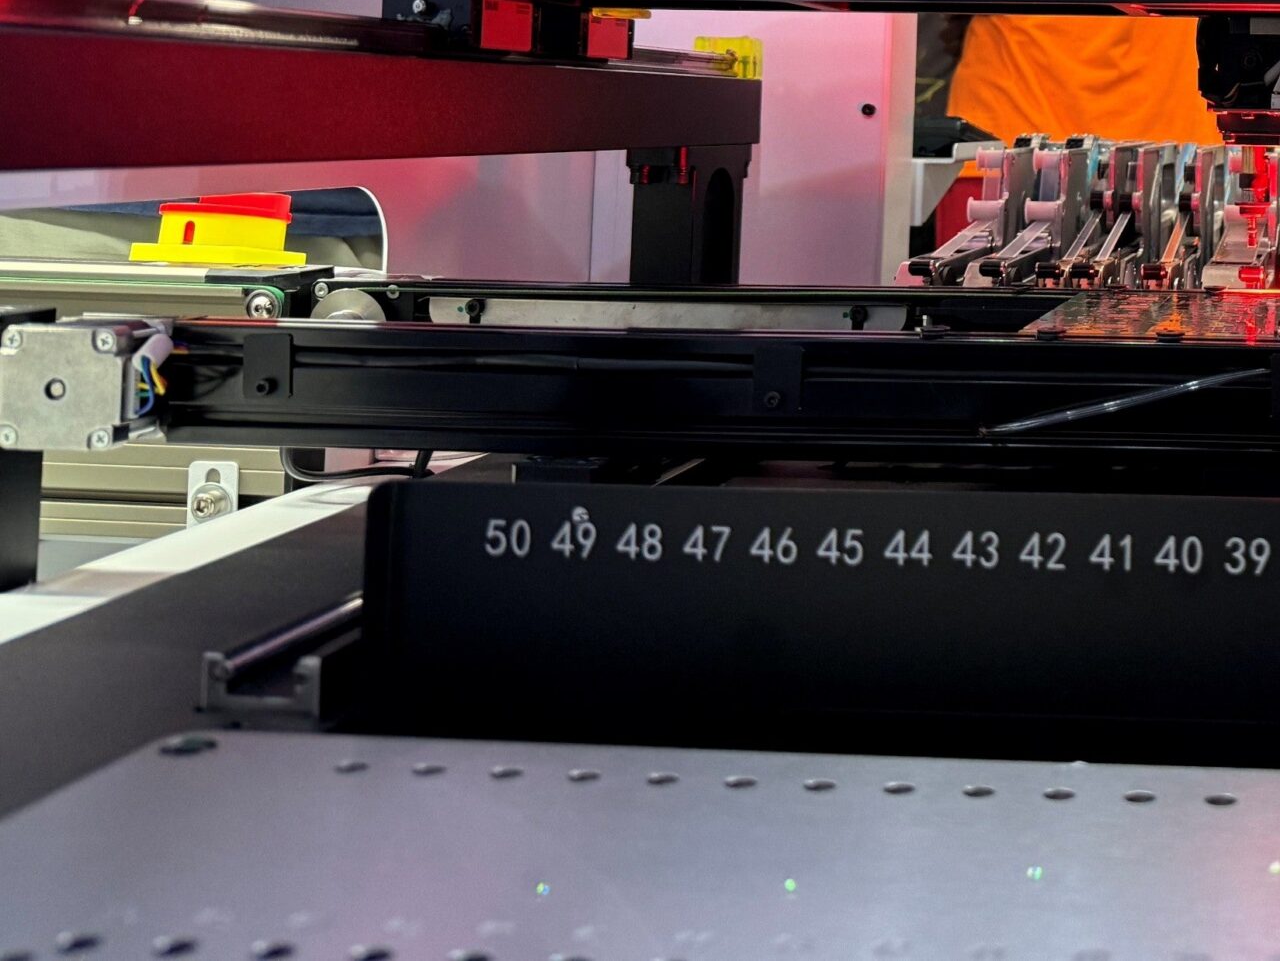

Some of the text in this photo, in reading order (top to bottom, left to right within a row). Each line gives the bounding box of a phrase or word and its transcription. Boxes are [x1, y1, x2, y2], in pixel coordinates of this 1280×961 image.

[485, 519, 531, 556] 50
[551, 520, 597, 558] 49
[616, 523, 662, 561] 48
[683, 525, 731, 562] 47
[749, 527, 798, 564] 46
[816, 528, 863, 566] 45
[883, 529, 933, 566] 44
[952, 530, 999, 568] 43
[1019, 532, 1066, 570] 42
[1089, 533, 1132, 571] 41
[1154, 535, 1203, 573] 40
[1225, 536, 1271, 574] 39
